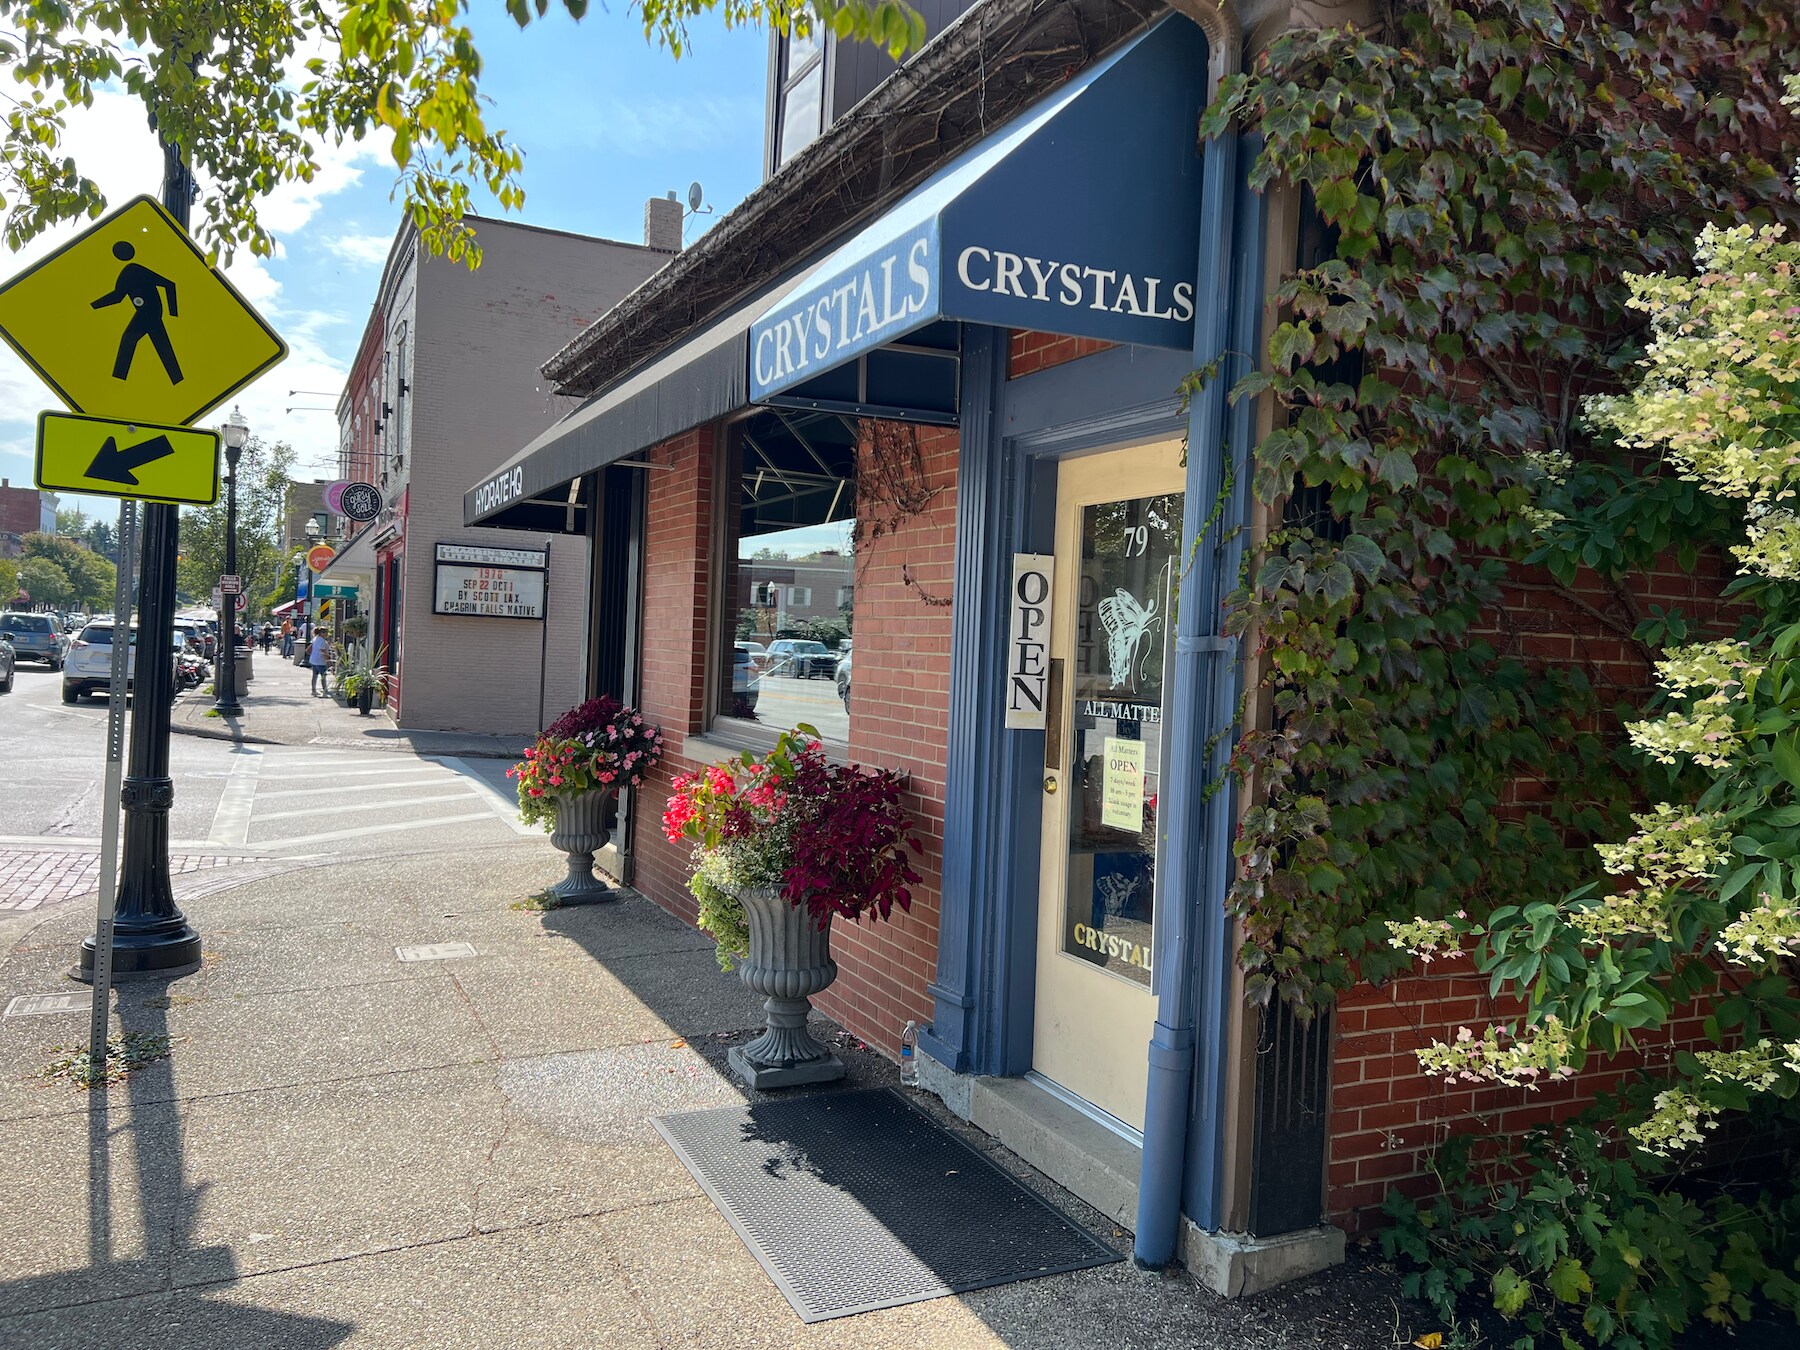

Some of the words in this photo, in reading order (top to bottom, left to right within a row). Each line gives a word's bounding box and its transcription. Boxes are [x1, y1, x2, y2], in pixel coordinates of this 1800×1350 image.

[957, 245, 1195, 322] CRYSTALS
[754, 238, 930, 387] CRYSTALS
[475, 472, 509, 516] HYDRATE
[509, 465, 523, 499] HQ
[1124, 525, 1149, 558] 79
[463, 579, 477, 589] SEP
[480, 580, 489, 590] 22
[493, 581, 507, 591] OCT
[509, 582, 513, 591] 1
[458, 591, 468, 600] BY
[473, 591, 499, 602] SCOTT
[504, 593, 523, 604] LAX.
[444, 601, 477, 613] CHAGRIN
[480, 603, 504, 614] FALLS
[507, 605, 535, 616] NATIVE
[1010, 571, 1049, 712] OPEN
[1083, 700, 1111, 718] ALL
[1111, 702, 1161, 723] MATTE
[1119, 745, 1138, 755] Matters
[1110, 758, 1137, 773] OPEN
[1113, 777, 1136, 787] days/week
[1121, 801, 1134, 810] usage
[1073, 922, 1152, 972] CRYSTAL
